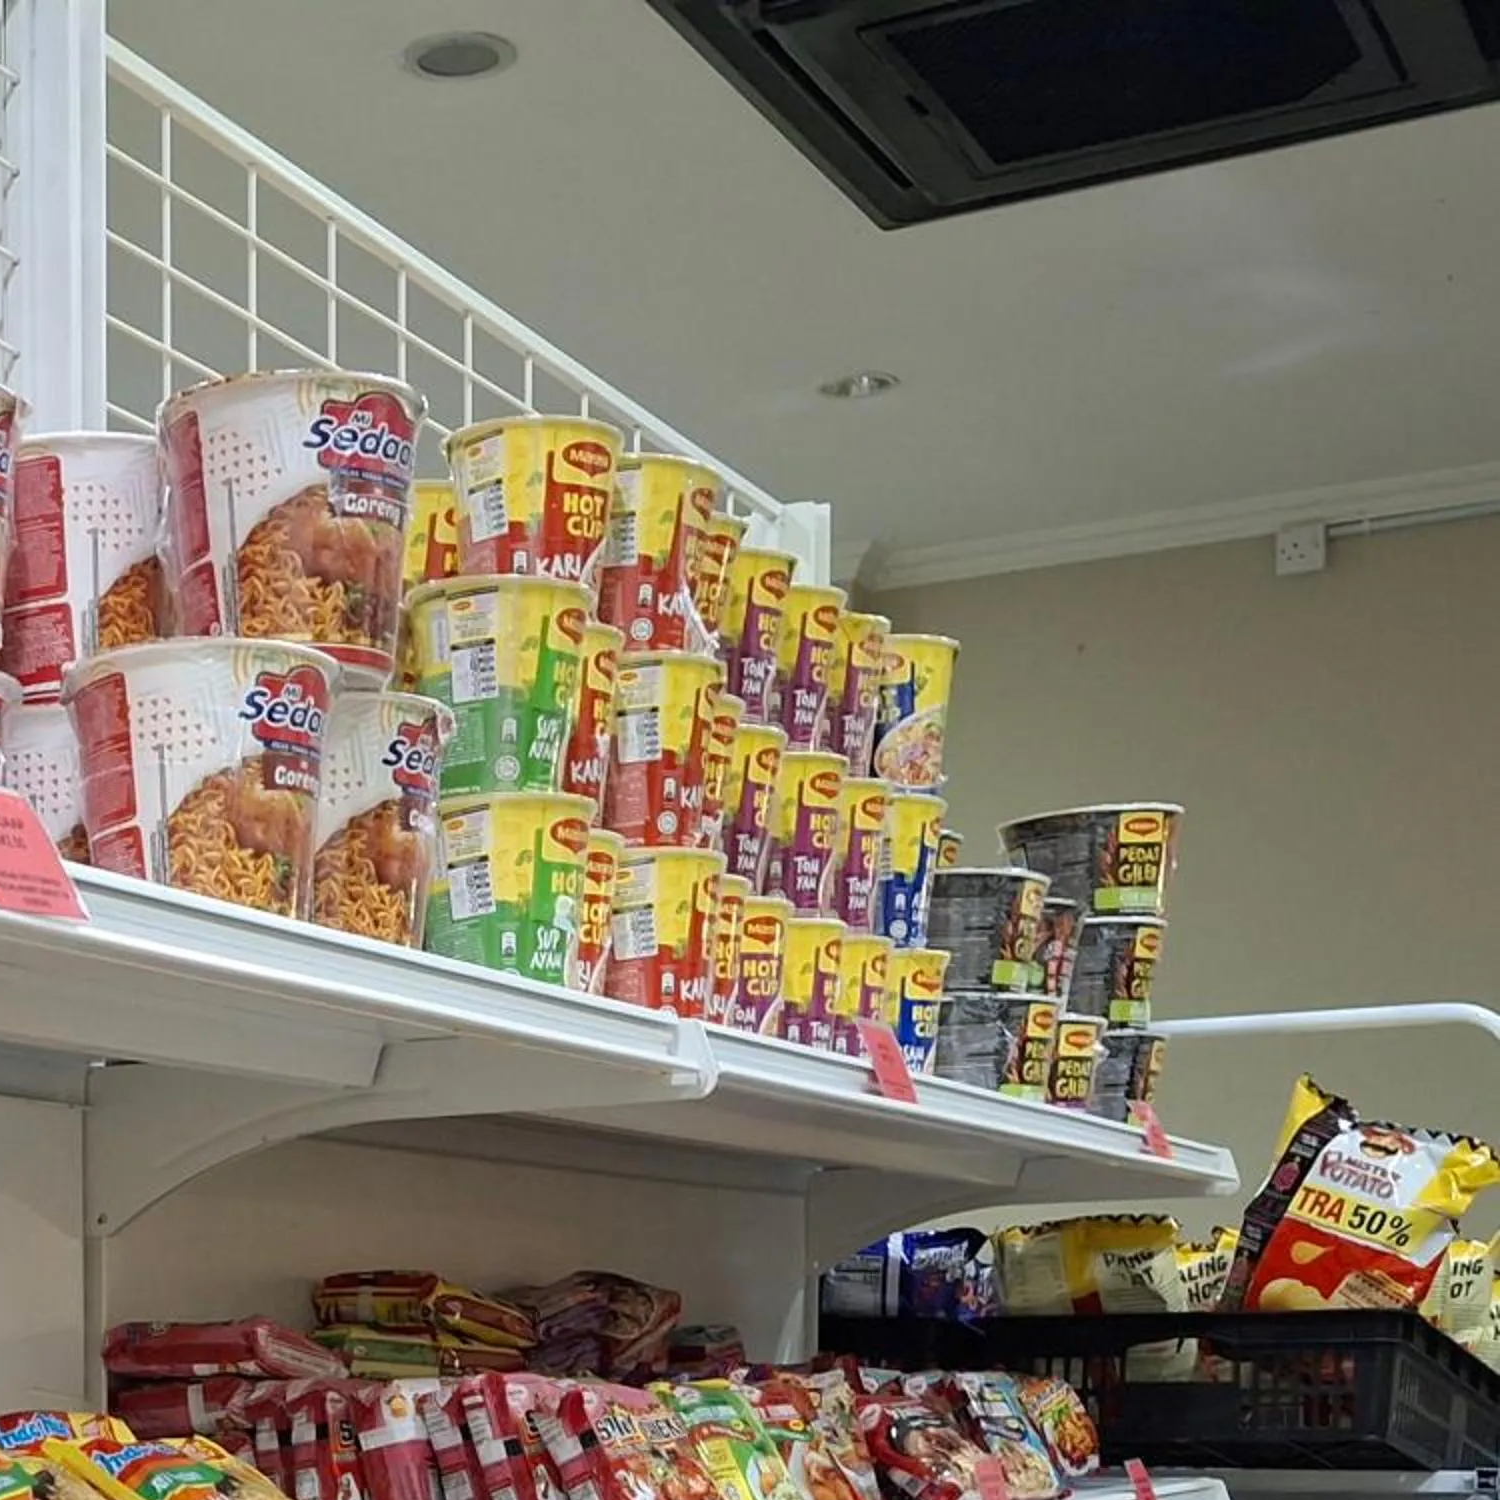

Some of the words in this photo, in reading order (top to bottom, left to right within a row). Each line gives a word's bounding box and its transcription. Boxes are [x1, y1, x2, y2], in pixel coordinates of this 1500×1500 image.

[562, 491, 606, 514] HOT
[535, 552, 582, 578] KARI
[551, 870, 578, 894] HO
[742, 959, 779, 977] HOT
[1318, 1151, 1395, 1200] POTATO
[1347, 1206, 1414, 1247] 50%
